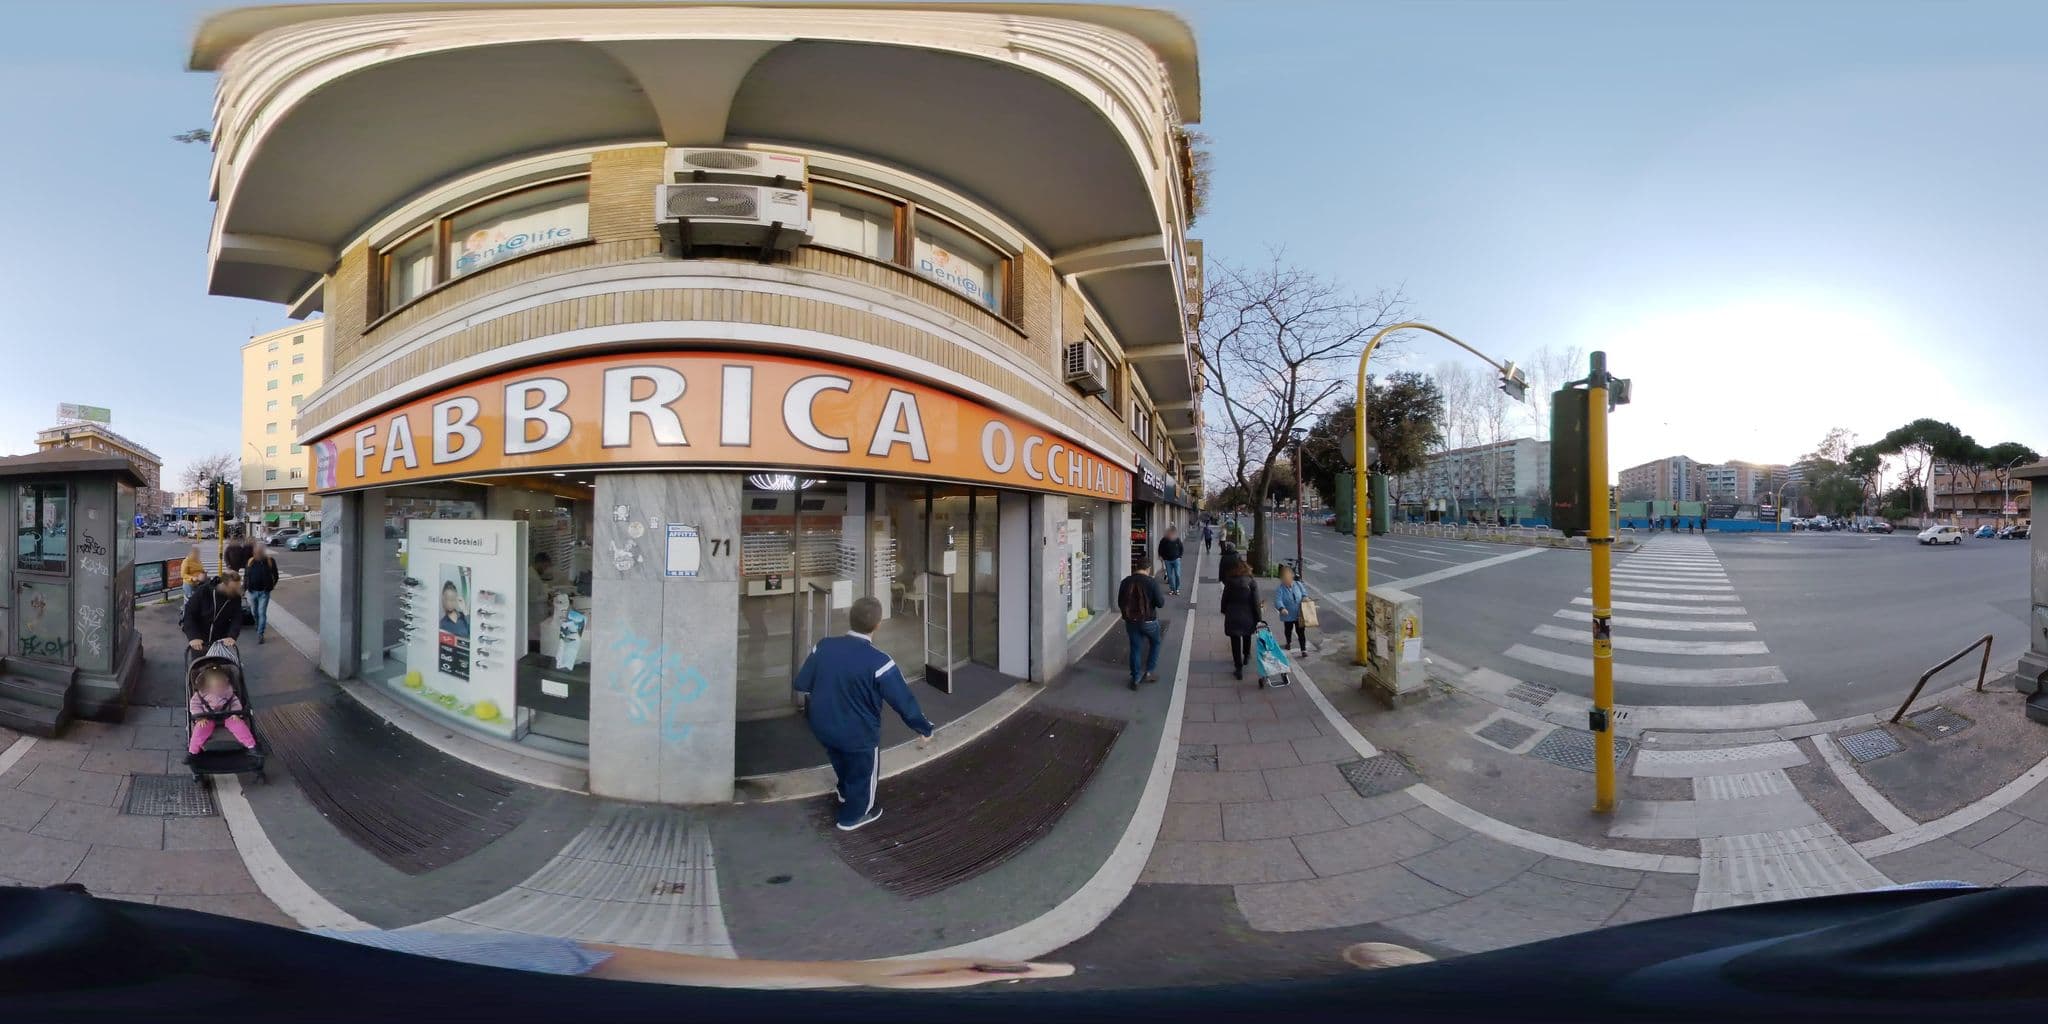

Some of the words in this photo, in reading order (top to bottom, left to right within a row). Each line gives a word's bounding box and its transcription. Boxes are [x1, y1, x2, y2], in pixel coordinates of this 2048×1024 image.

[353, 363, 932, 479] FABBRICA
[979, 419, 1121, 496] OCCHIALI
[711, 539, 731, 557] 71
